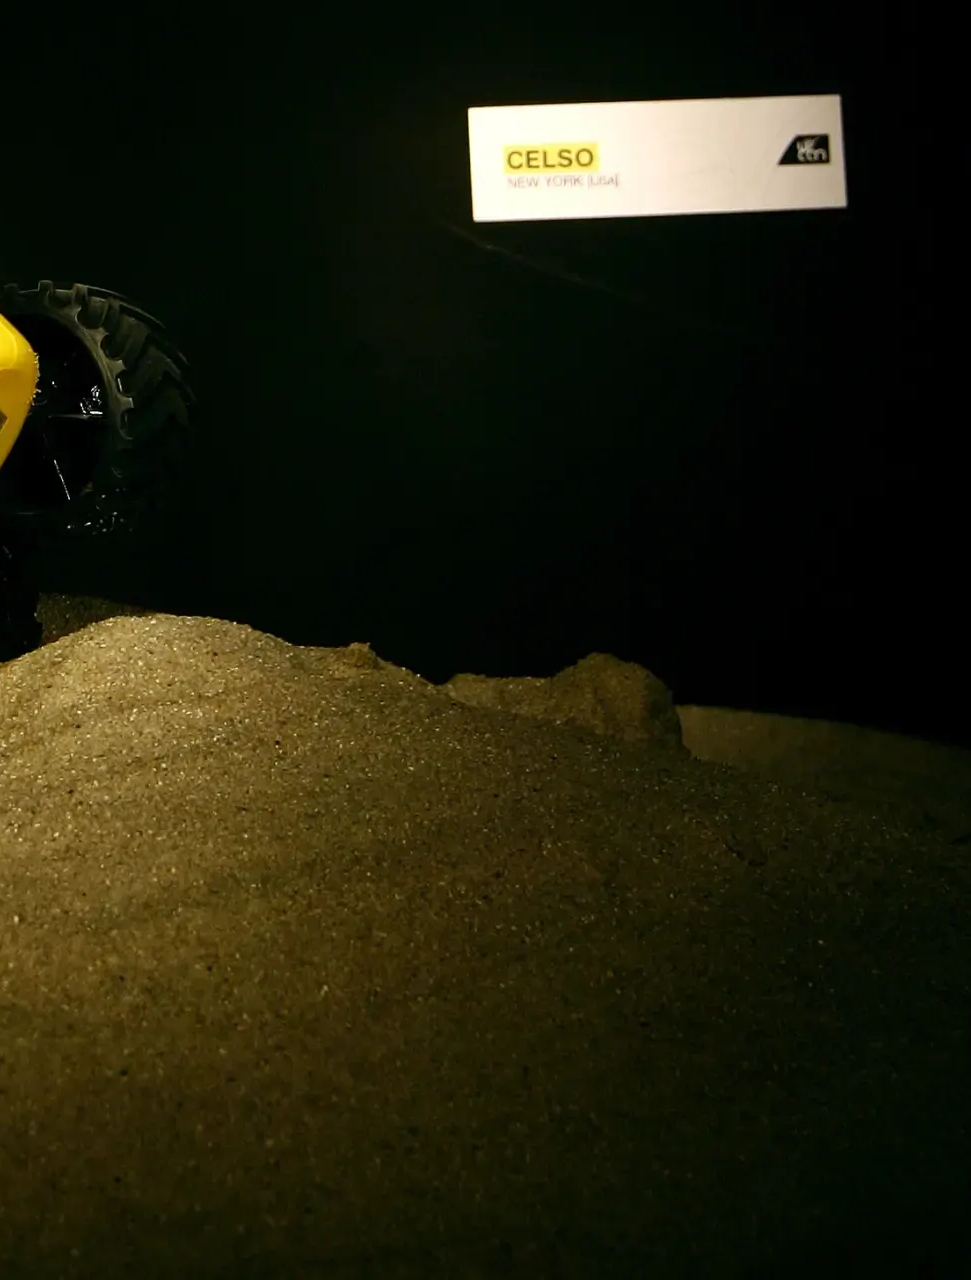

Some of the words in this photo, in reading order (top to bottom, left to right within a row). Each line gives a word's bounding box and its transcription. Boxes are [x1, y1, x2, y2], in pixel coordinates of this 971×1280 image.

[507, 147, 594, 169] CELSO
[507, 176, 538, 188] NEW
[545, 174, 583, 187] YORK
